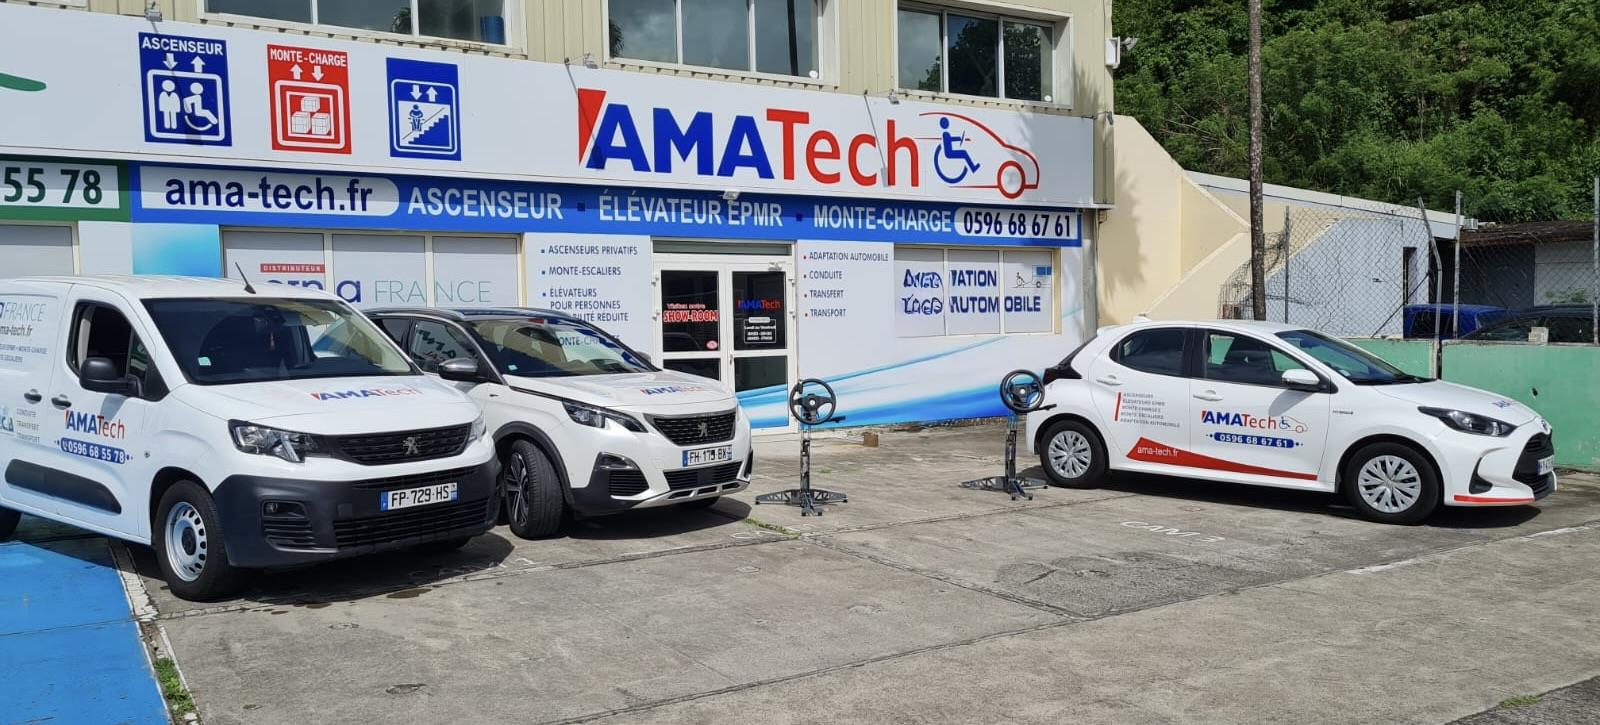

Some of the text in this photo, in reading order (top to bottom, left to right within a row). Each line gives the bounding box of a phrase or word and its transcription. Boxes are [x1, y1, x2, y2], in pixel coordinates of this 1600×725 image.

[142, 36, 224, 56] ASCENSEUR
[269, 48, 347, 68] MONTE-CHARGE
[578, 91, 920, 188] AMATech
[3, 169, 102, 203] 55 78
[164, 176, 373, 212] ama-tech.fr
[407, 186, 564, 220] ASCENSEUR
[599, 189, 721, 224] ÉLÉVATEUR
[813, 204, 953, 233] MONTE-CHARGE
[963, 210, 1070, 237] 0596 68 67 61
[548, 245, 637, 256] ASCENSEURS PRIVATIFS
[809, 252, 889, 262] ADAPTATION AUTOMOBILE
[549, 266, 621, 276] MONTE-ESCALIERS
[809, 270, 842, 280] CONDUITE
[375, 280, 491, 303] FRANCE
[810, 289, 844, 299] TRANSFERT
[5, 302, 46, 321] FRANCE
[550, 301, 620, 310] POUR PERSONNES
[811, 308, 846, 318] TRANSPORT
[597, 310, 629, 322] RÉDUITE
[663, 310, 719, 323] SHOW-ROOM
[0, 324, 32, 337] ma-tech.fr
[67, 410, 125, 440] AMATech
[1204, 411, 1277, 430] AMATech
[1219, 433, 1288, 448] 0596 68 67 61
[69, 441, 125, 463] 0596 68 55 78
[1137, 446, 1179, 457] ama-tech.fr
